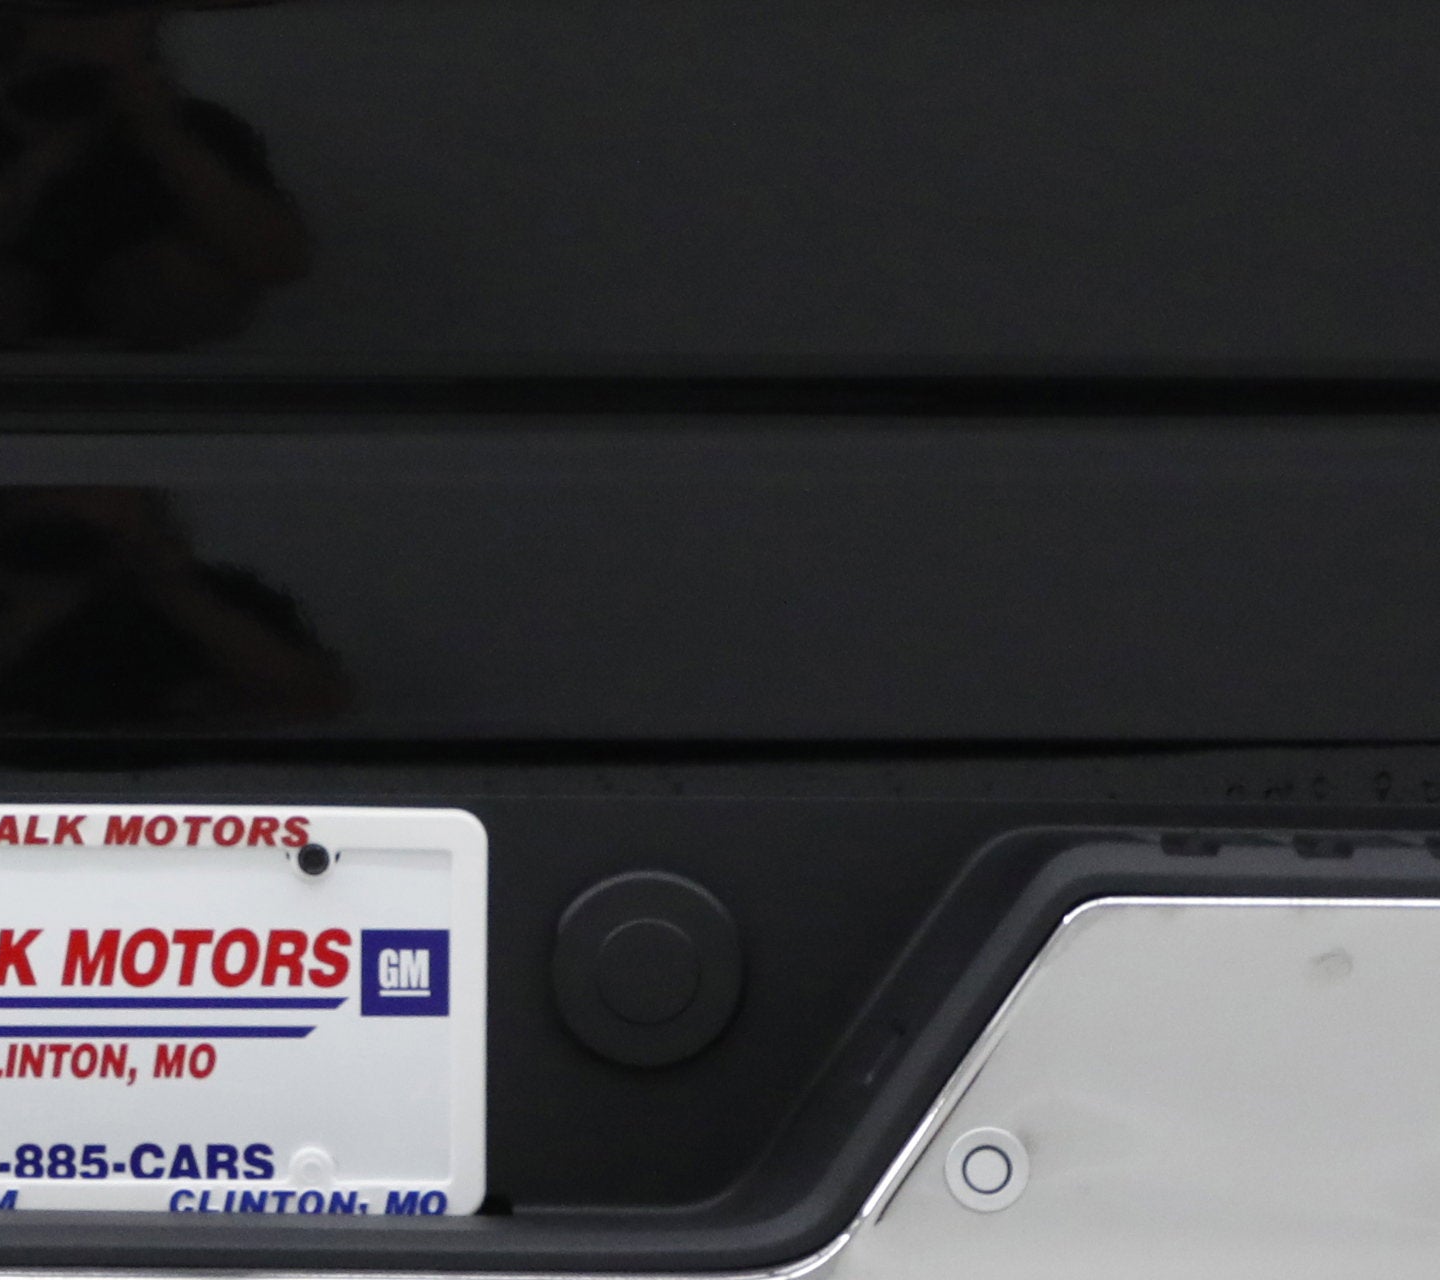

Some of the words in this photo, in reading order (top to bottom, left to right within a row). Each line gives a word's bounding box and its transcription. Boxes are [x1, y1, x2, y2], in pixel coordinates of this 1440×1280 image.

[103, 815, 311, 848] MOTORS
[61, 927, 353, 989] MOTORS
[378, 948, 431, 990] GM
[153, 1043, 217, 1080] MO
[385, 1190, 448, 1216] MO
